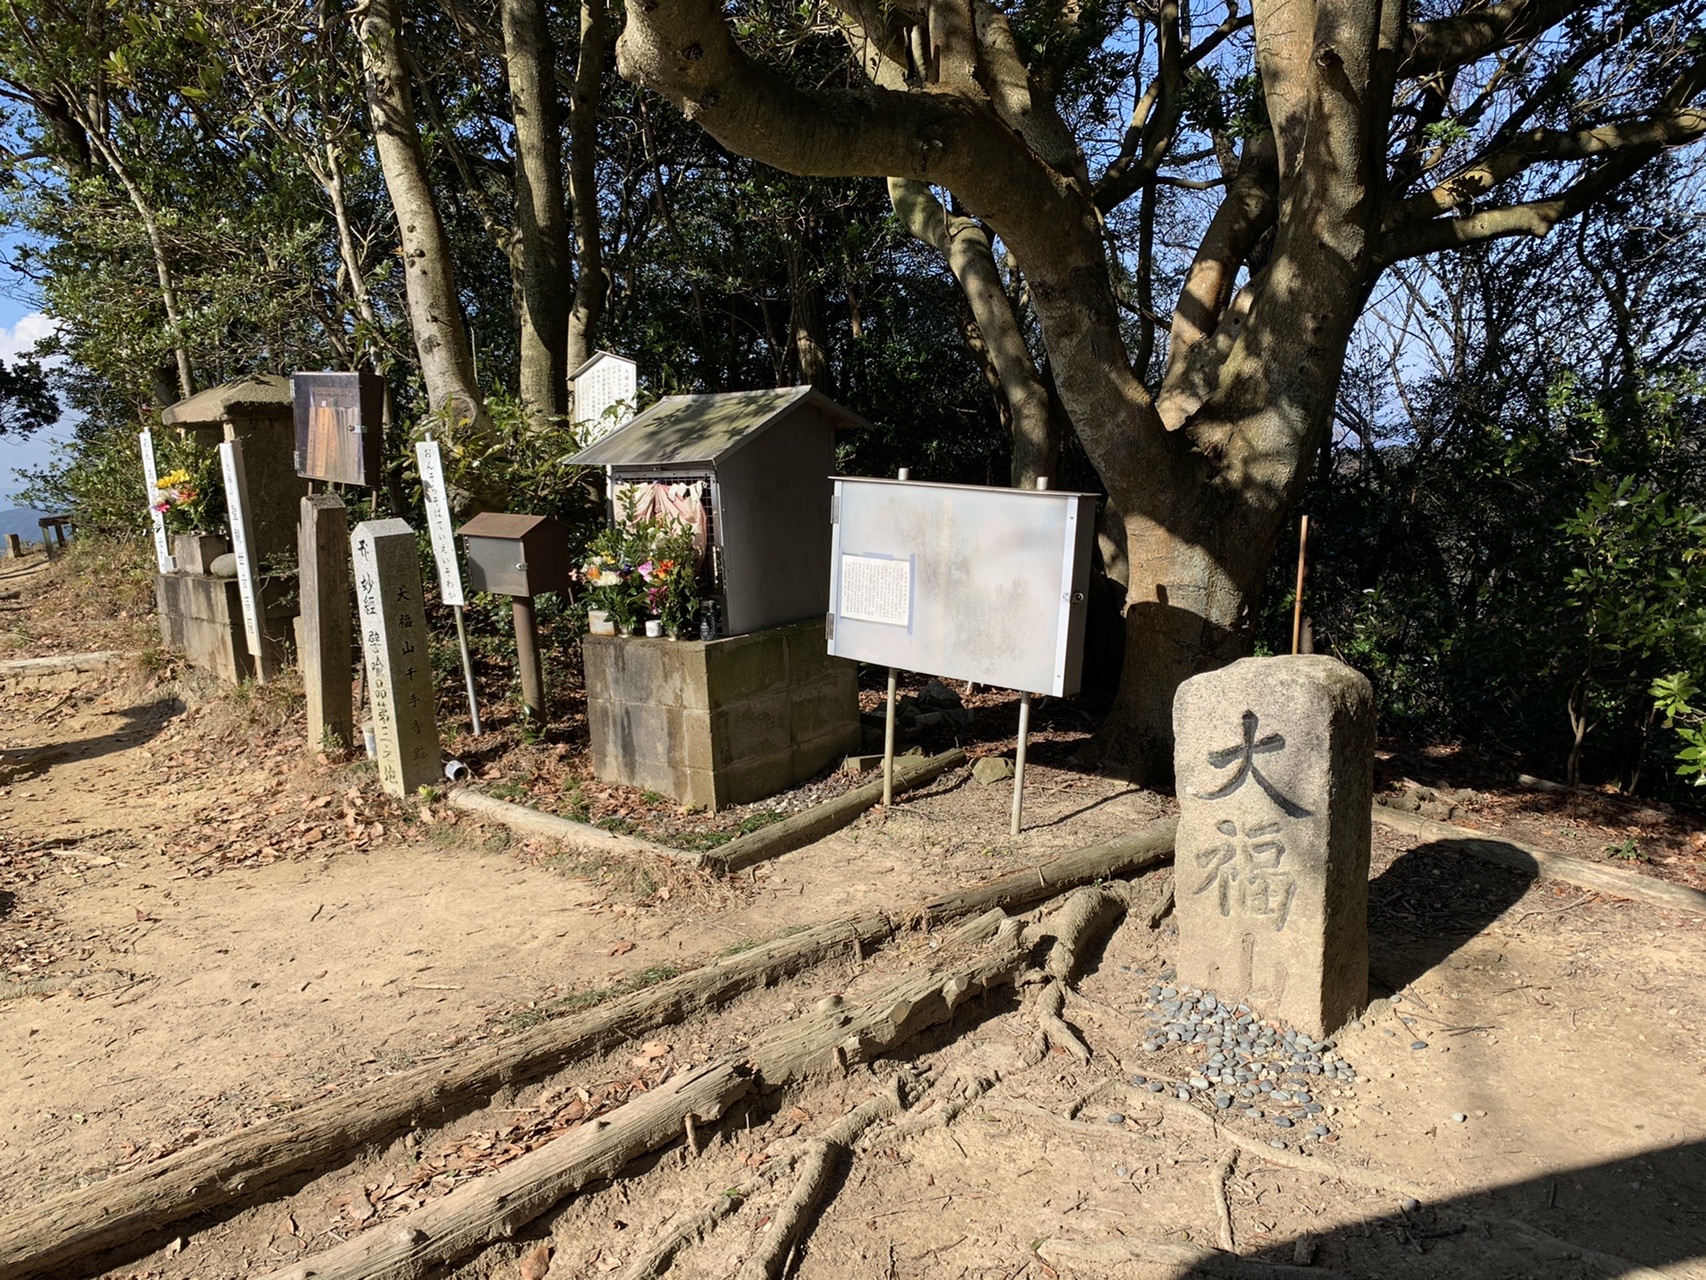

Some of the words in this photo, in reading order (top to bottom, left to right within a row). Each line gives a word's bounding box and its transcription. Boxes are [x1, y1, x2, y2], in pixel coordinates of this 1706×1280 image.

[396, 586, 428, 762] 大福山千手寺跡
